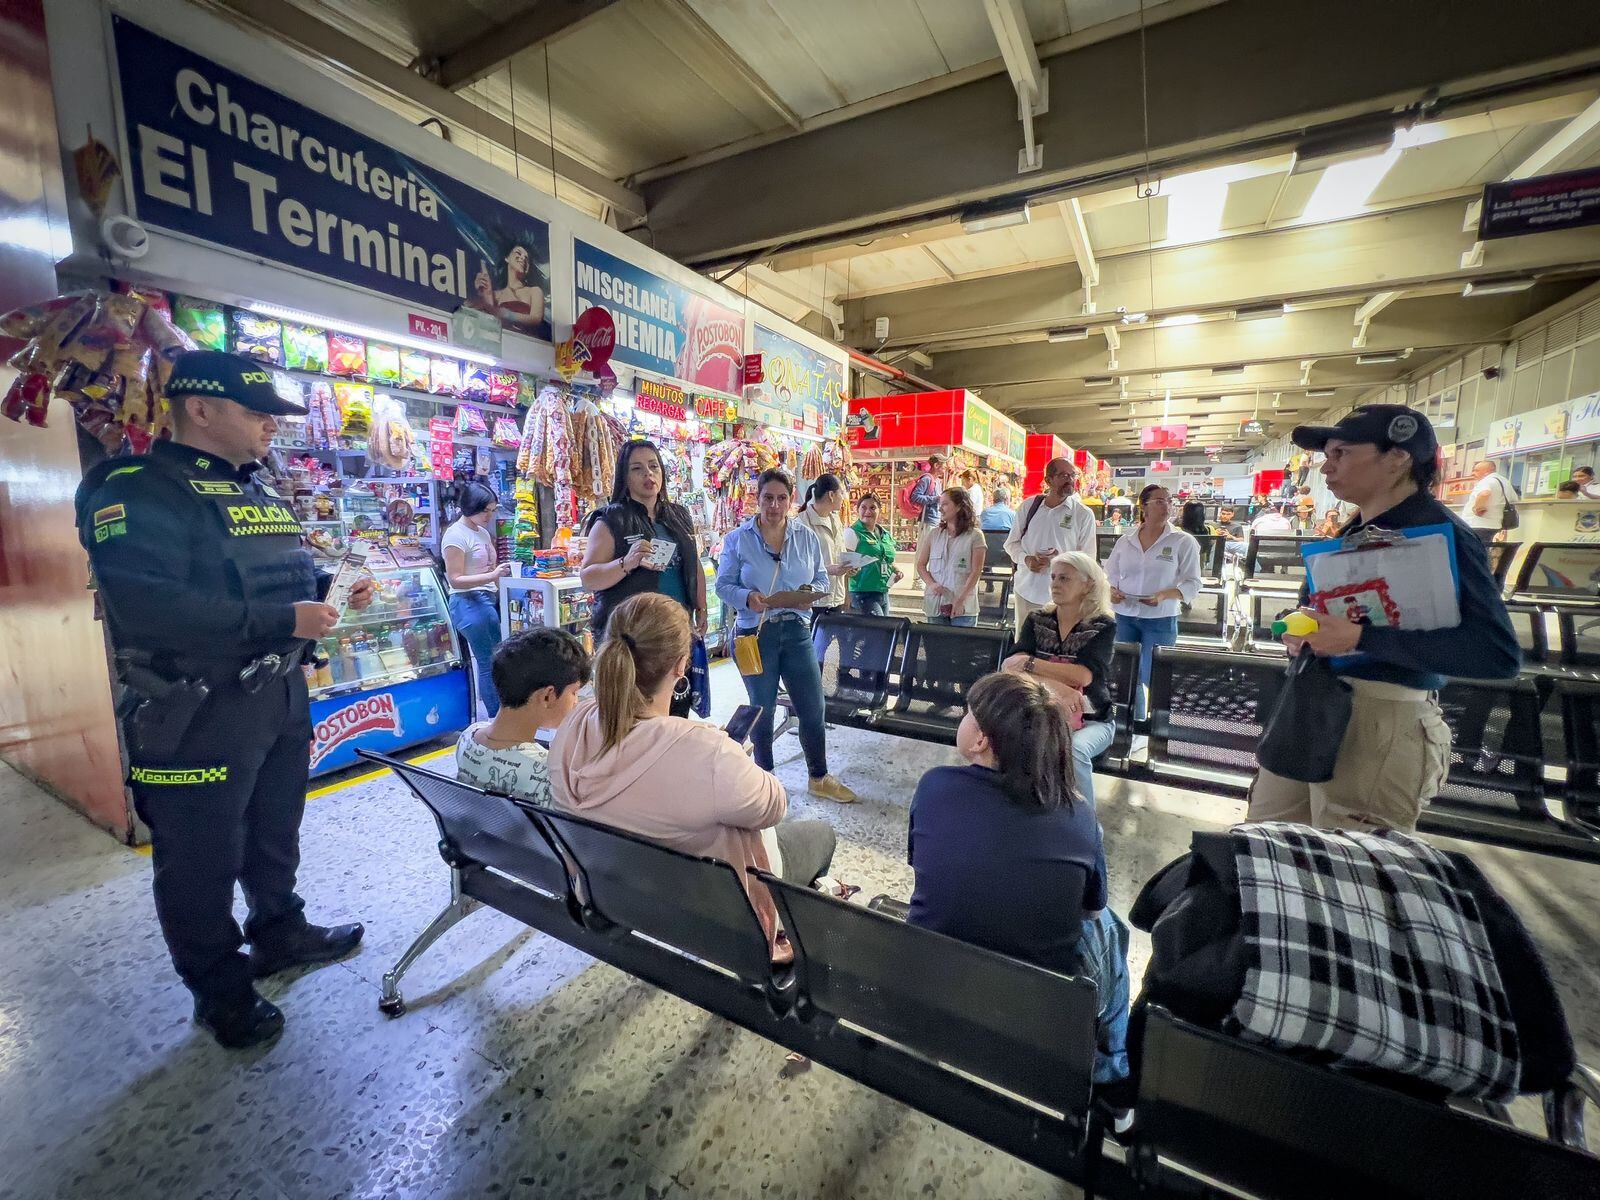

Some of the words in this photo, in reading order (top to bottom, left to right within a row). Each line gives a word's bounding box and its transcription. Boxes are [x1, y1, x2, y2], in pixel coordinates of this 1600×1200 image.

[176, 68, 438, 222] Charcuteria
[138, 124, 213, 216] El
[233, 161, 467, 298] Terminal
[577, 261, 677, 325] MISCELANEA
[578, 297, 676, 363] HEMIA
[697, 321, 742, 348] POSTOBON
[641, 380, 684, 405] MINUTOS
[636, 394, 687, 421] RECARGAS
[227, 502, 296, 524] POLICÍA
[146, 773, 198, 782] POLICÍA
